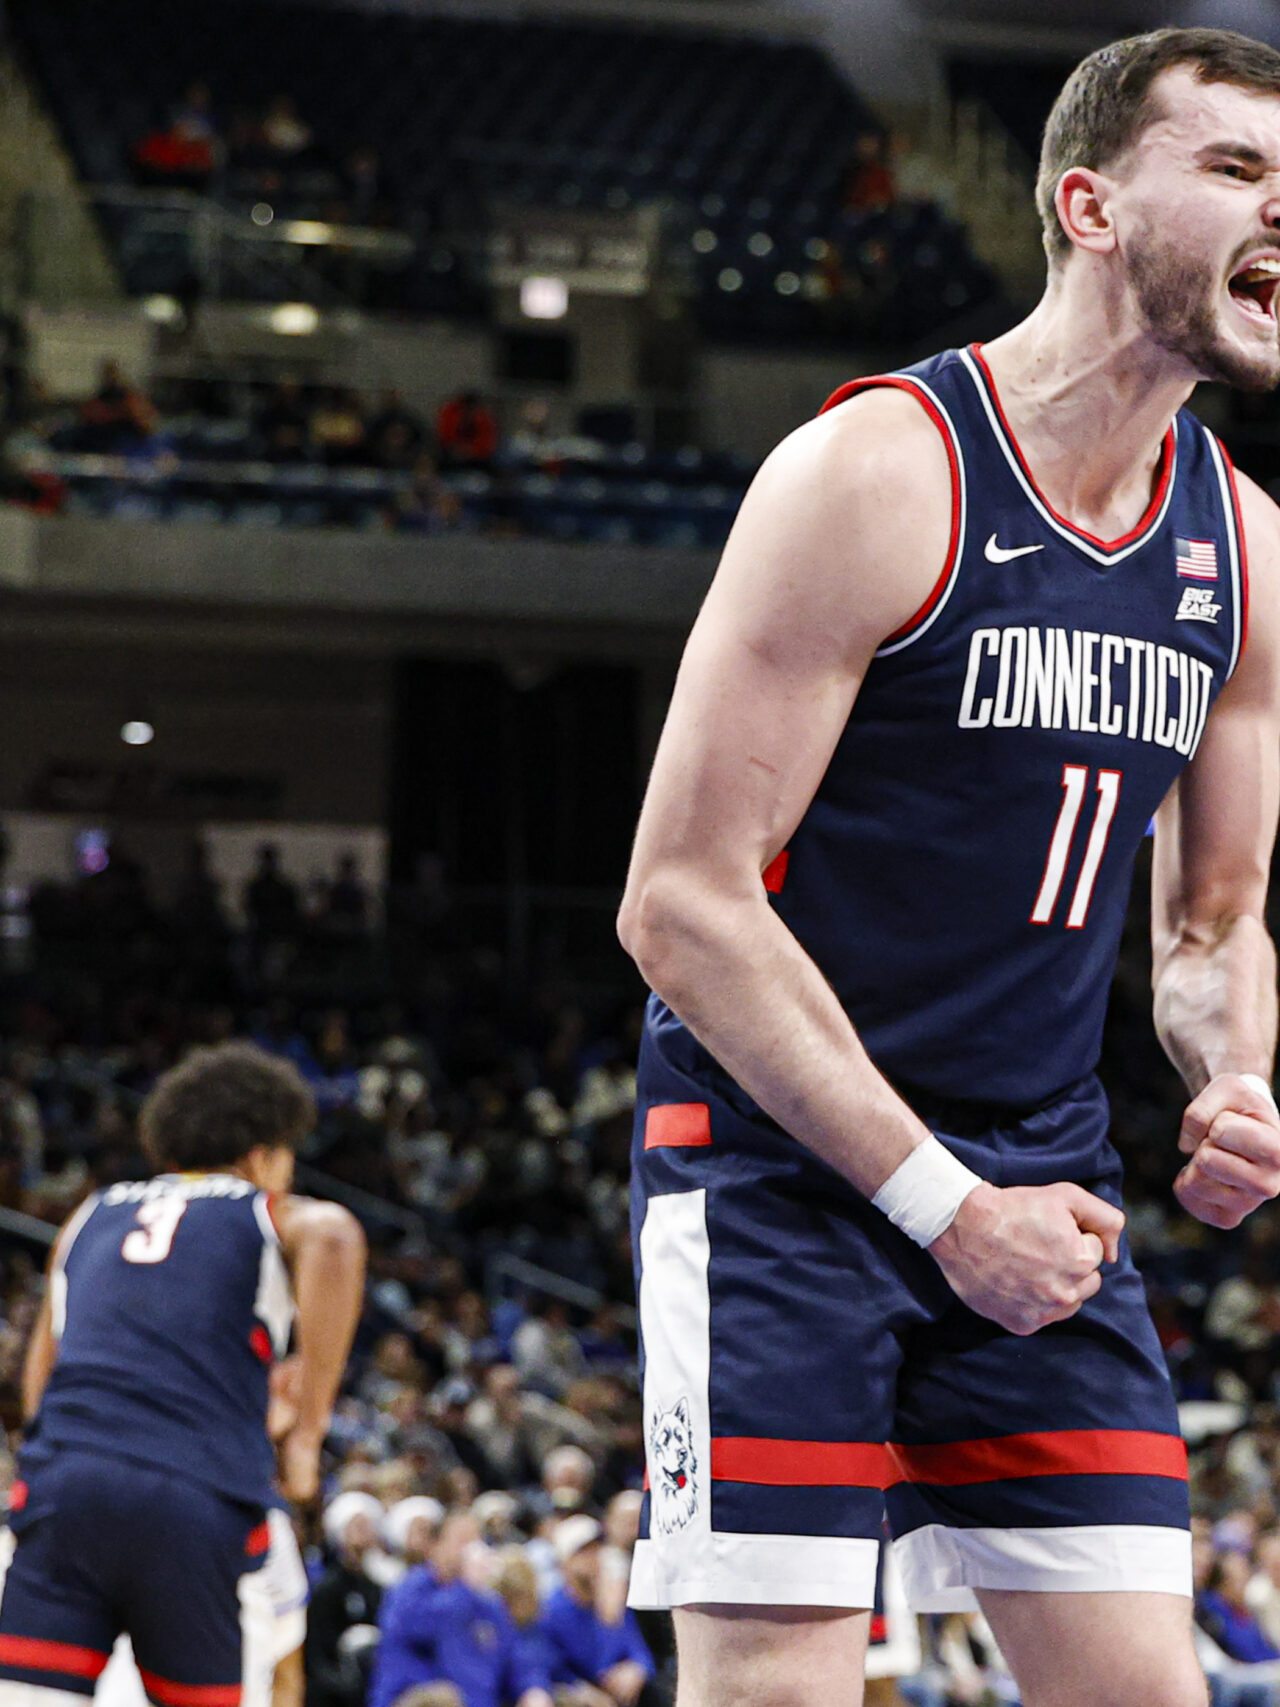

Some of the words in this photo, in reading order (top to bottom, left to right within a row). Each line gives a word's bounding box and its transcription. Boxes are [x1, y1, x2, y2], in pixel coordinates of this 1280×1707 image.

[1177, 600, 1222, 618] EAST
[1181, 586, 1215, 604] BIG
[958, 626, 1214, 761] CONNECTICUT
[1029, 763, 1123, 930] 11
[121, 1196, 188, 1265] 3
